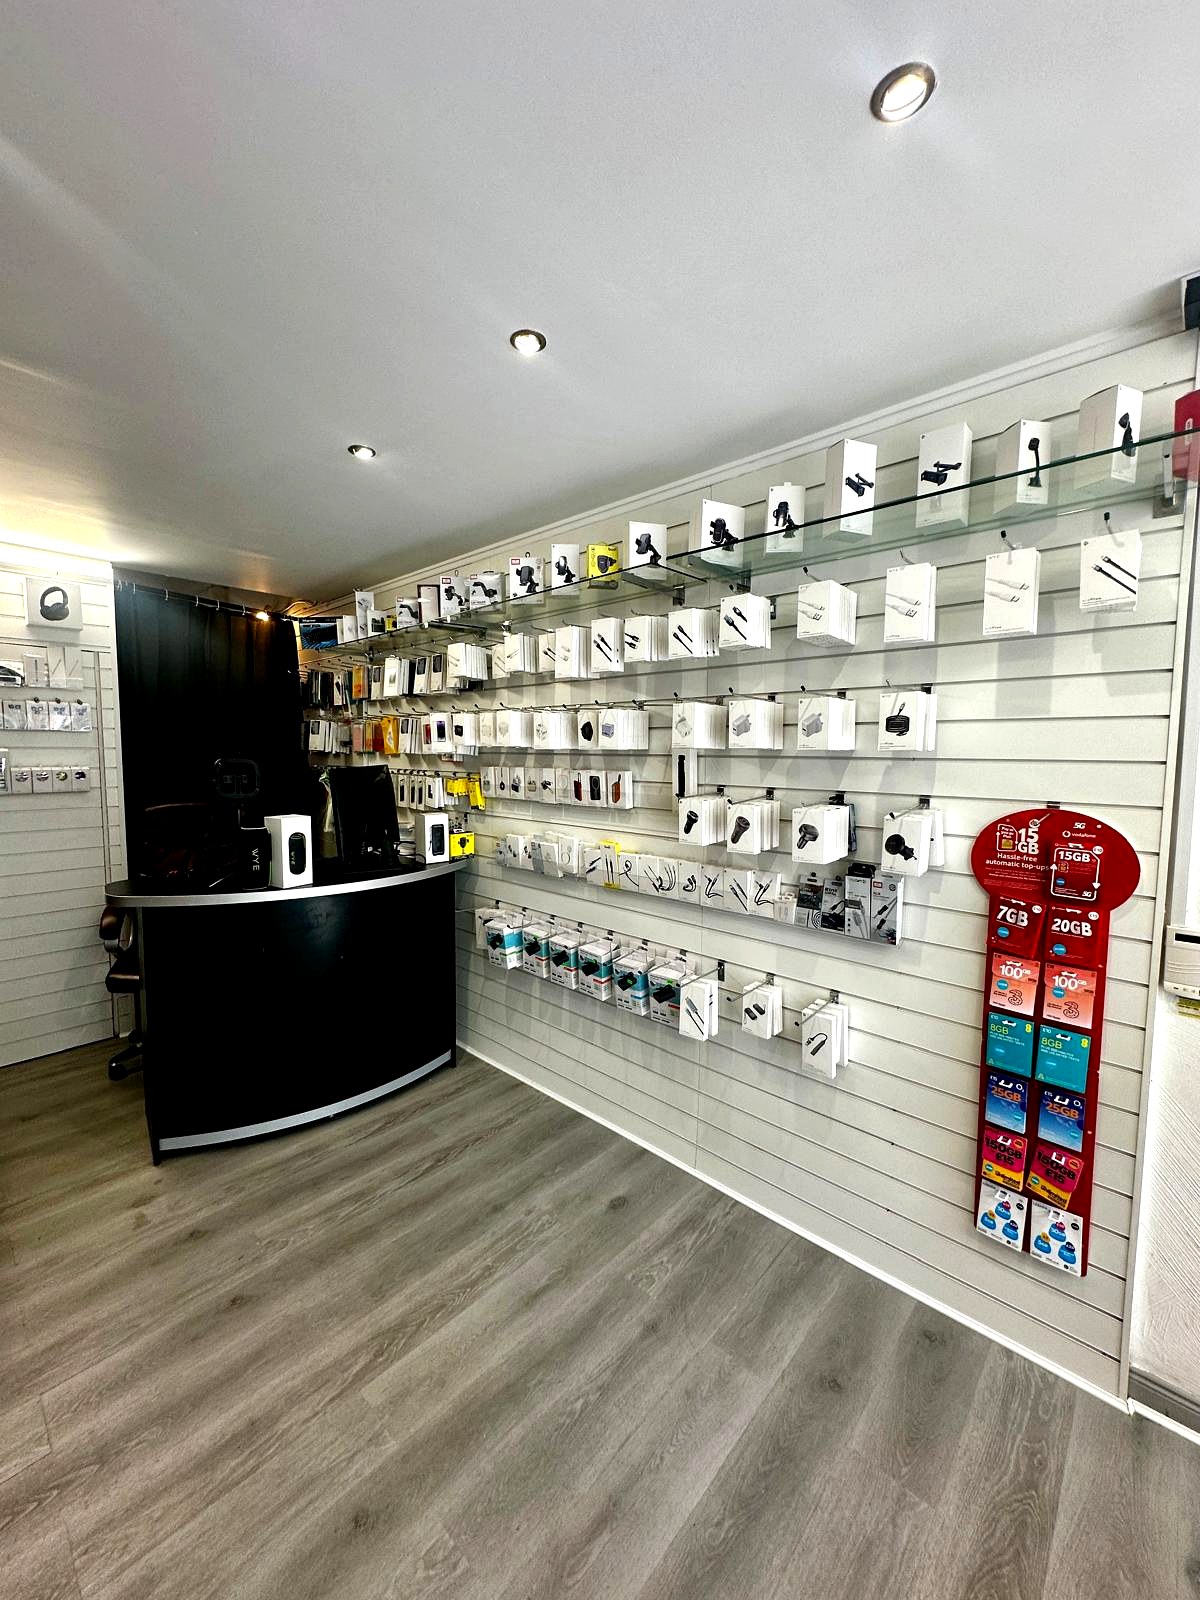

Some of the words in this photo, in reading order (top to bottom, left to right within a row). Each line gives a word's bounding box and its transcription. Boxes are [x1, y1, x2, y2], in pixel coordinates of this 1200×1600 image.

[1018, 828, 1039, 843] 15
[1017, 841, 1039, 855] GB
[252, 848, 260, 871] WYE
[985, 859, 1021, 868] automatic
[997, 853, 1038, 862] Hassle-free
[1058, 850, 1091, 863] 15GB
[996, 905, 1028, 927] 7GB
[1051, 918, 1093, 937] 20GB
[990, 1024, 1009, 1035] 8GB
[1041, 1037, 1062, 1049] 8GB
[991, 1086, 1022, 1102] 25GB
[1045, 1101, 1079, 1119] 25GB
[1045, 1168, 1065, 1184] £15
